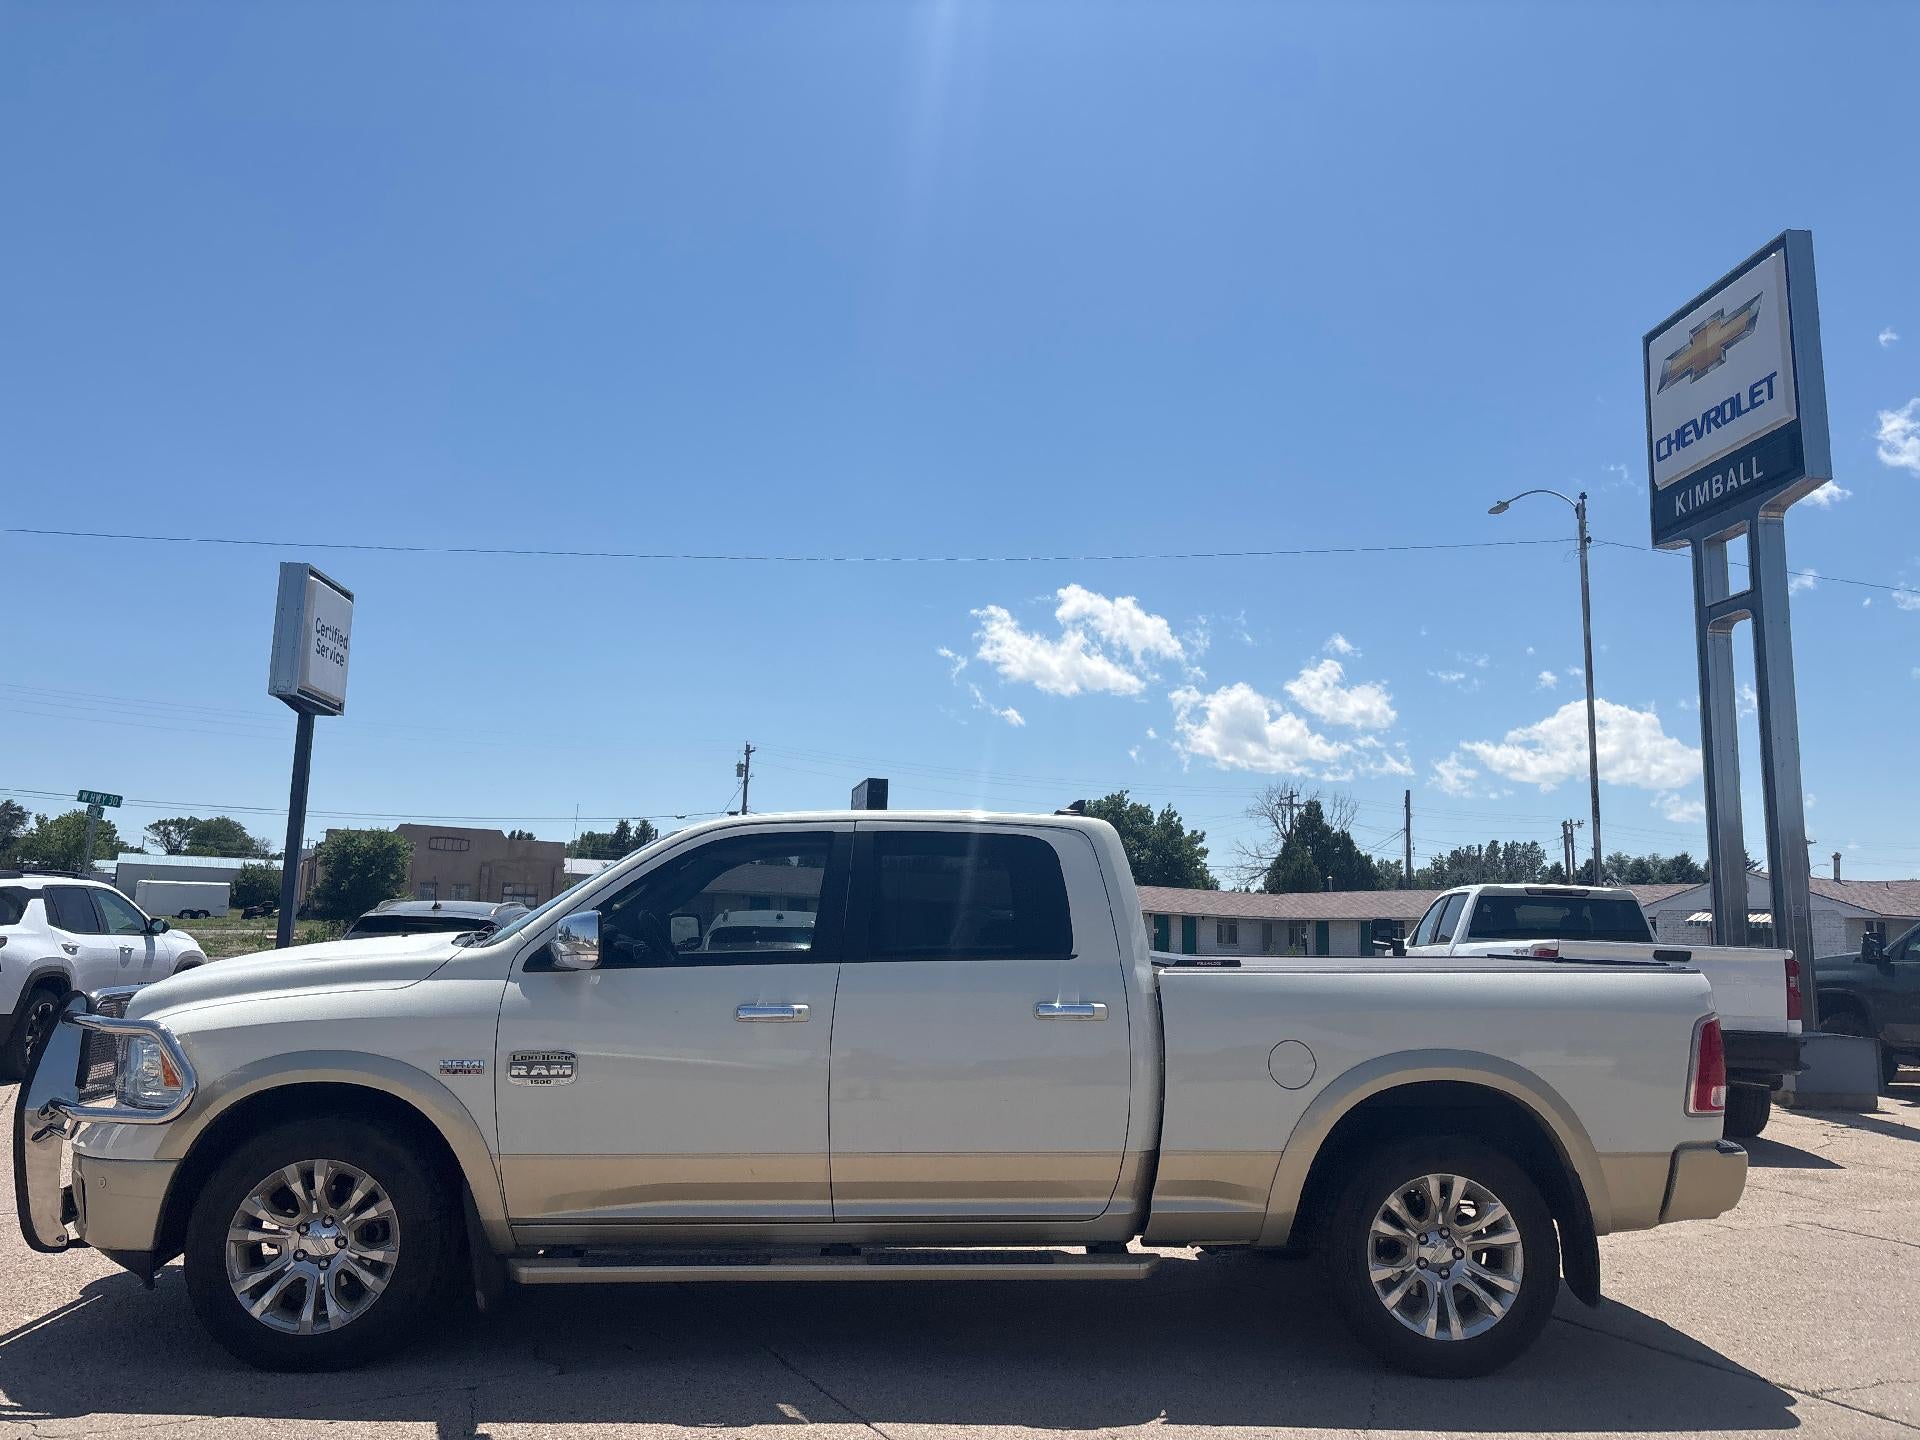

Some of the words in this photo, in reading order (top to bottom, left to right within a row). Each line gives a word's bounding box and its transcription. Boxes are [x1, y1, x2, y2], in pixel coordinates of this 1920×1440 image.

[1655, 371, 1777, 463] CHEVROLET
[1675, 456, 1764, 517] KIMBALL
[315, 617, 349, 651] Certified
[315, 638, 345, 667] Service
[82, 791, 89, 802] W
[90, 793, 107, 806] HWY
[109, 796, 119, 806] 30
[439, 1059, 485, 1068] HEMI
[511, 1064, 572, 1076] RAM
